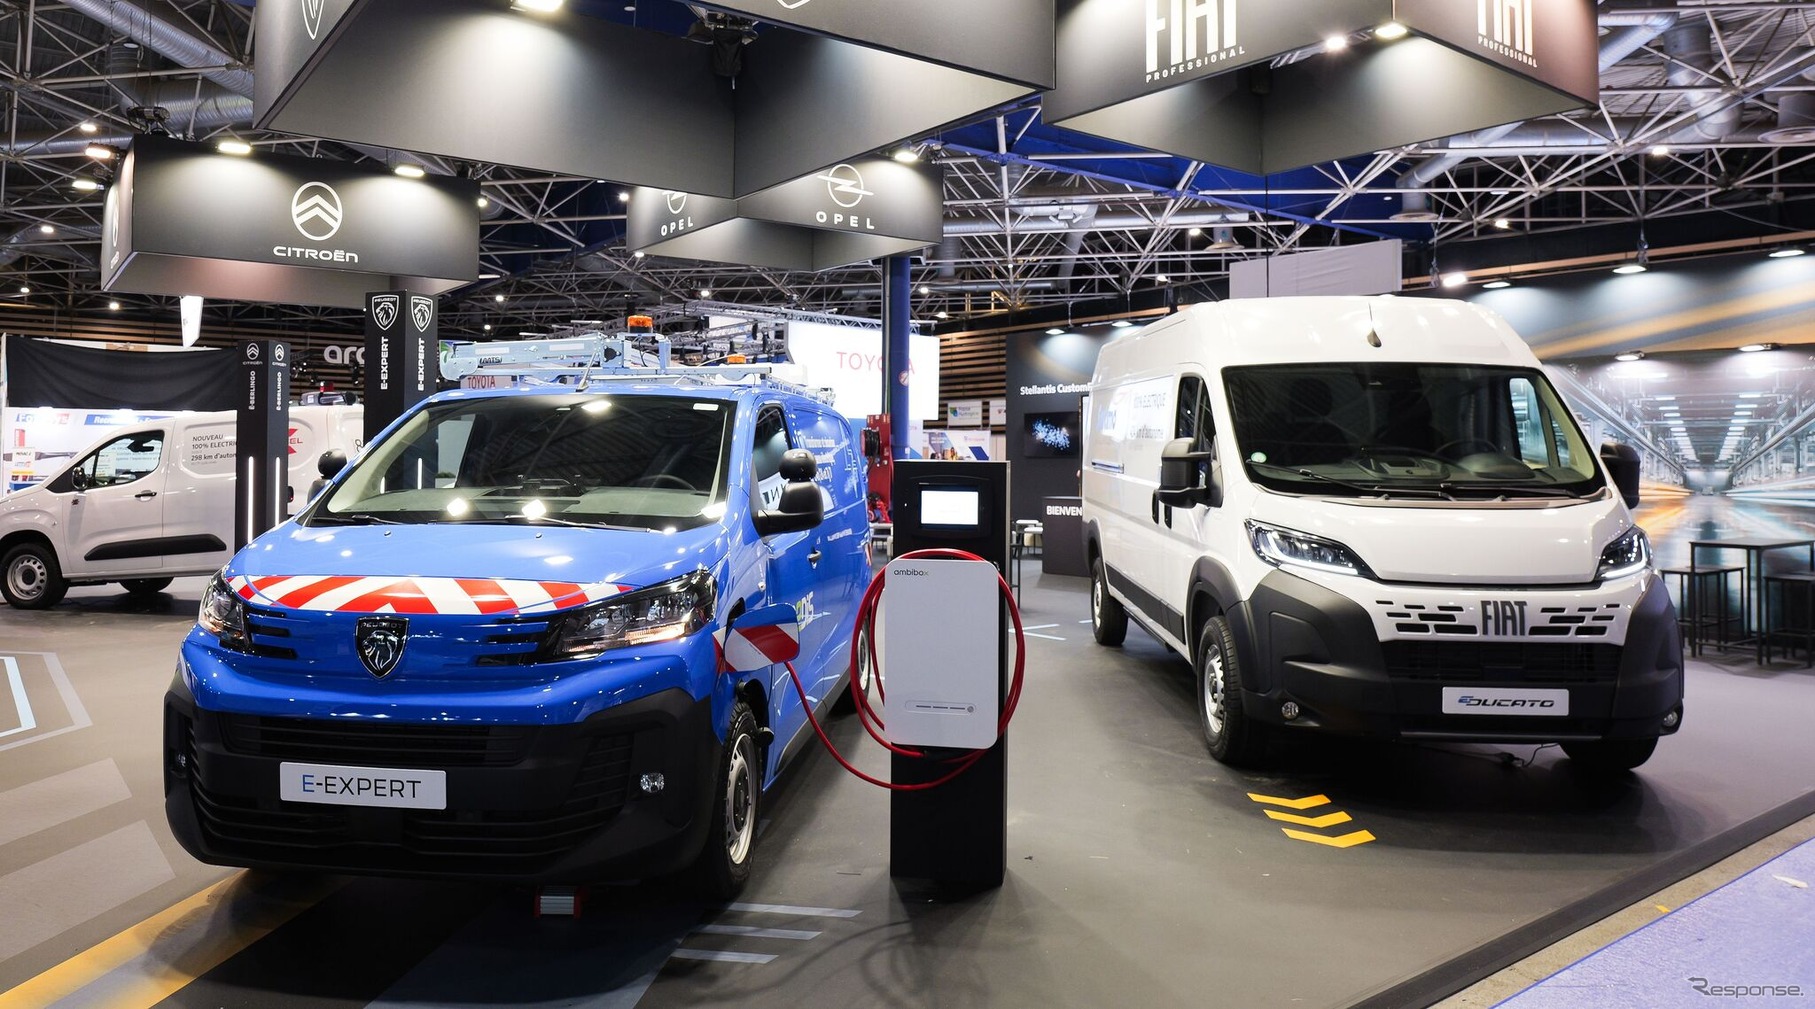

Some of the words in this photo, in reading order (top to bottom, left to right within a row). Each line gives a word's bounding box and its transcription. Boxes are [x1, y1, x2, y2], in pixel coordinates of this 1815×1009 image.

[1478, 35, 1538, 68] PROFESSIONAL
[1146, 46, 1245, 83] PROFESSIONAL
[660, 216, 694, 237] OPEL
[816, 211, 875, 230] OPEL
[273, 246, 359, 263] CITROËN
[380, 336, 389, 390] E-EXPERT
[467, 375, 496, 389] TOYOTA
[1020, 384, 1056, 396] Stellantis
[192, 442, 209, 450] 100%
[193, 434, 224, 442] NOUVEAU
[893, 568, 929, 576] ambibox
[1480, 600, 1528, 636] FIAT
[302, 774, 422, 798] E-EXPERT
